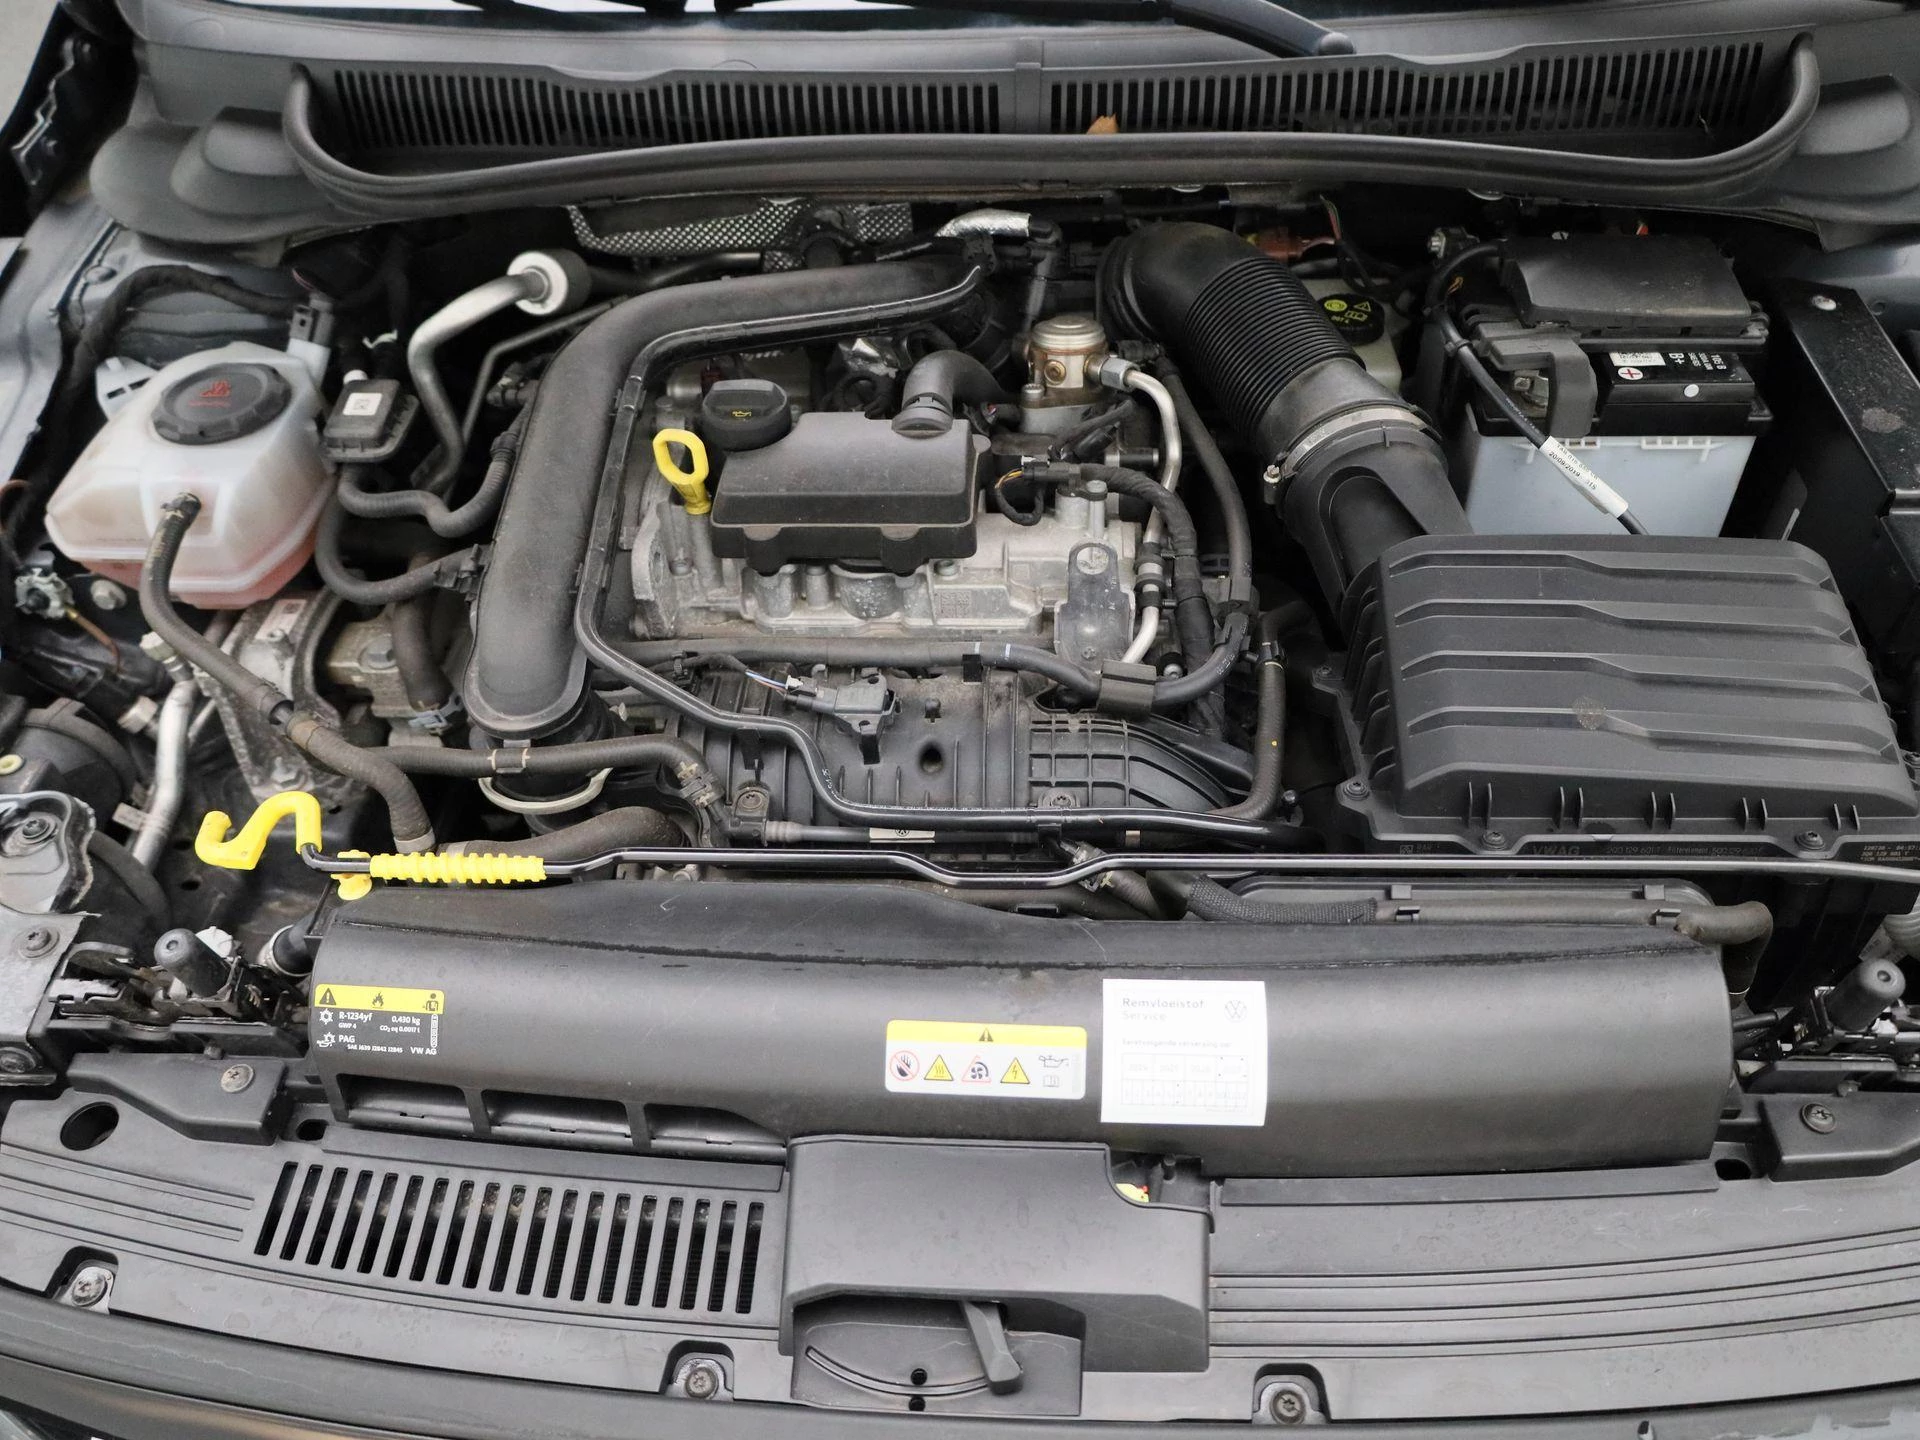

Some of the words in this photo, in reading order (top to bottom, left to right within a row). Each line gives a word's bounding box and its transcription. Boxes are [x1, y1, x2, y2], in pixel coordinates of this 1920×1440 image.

[1122, 998, 1205, 1009] Remvloeistof
[339, 1012, 373, 1023] R-1234yf
[412, 1016, 421, 1026] kg
[1122, 1010, 1168, 1022] Service
[339, 1035, 355, 1043] PAG
[410, 1047, 424, 1055] VW
